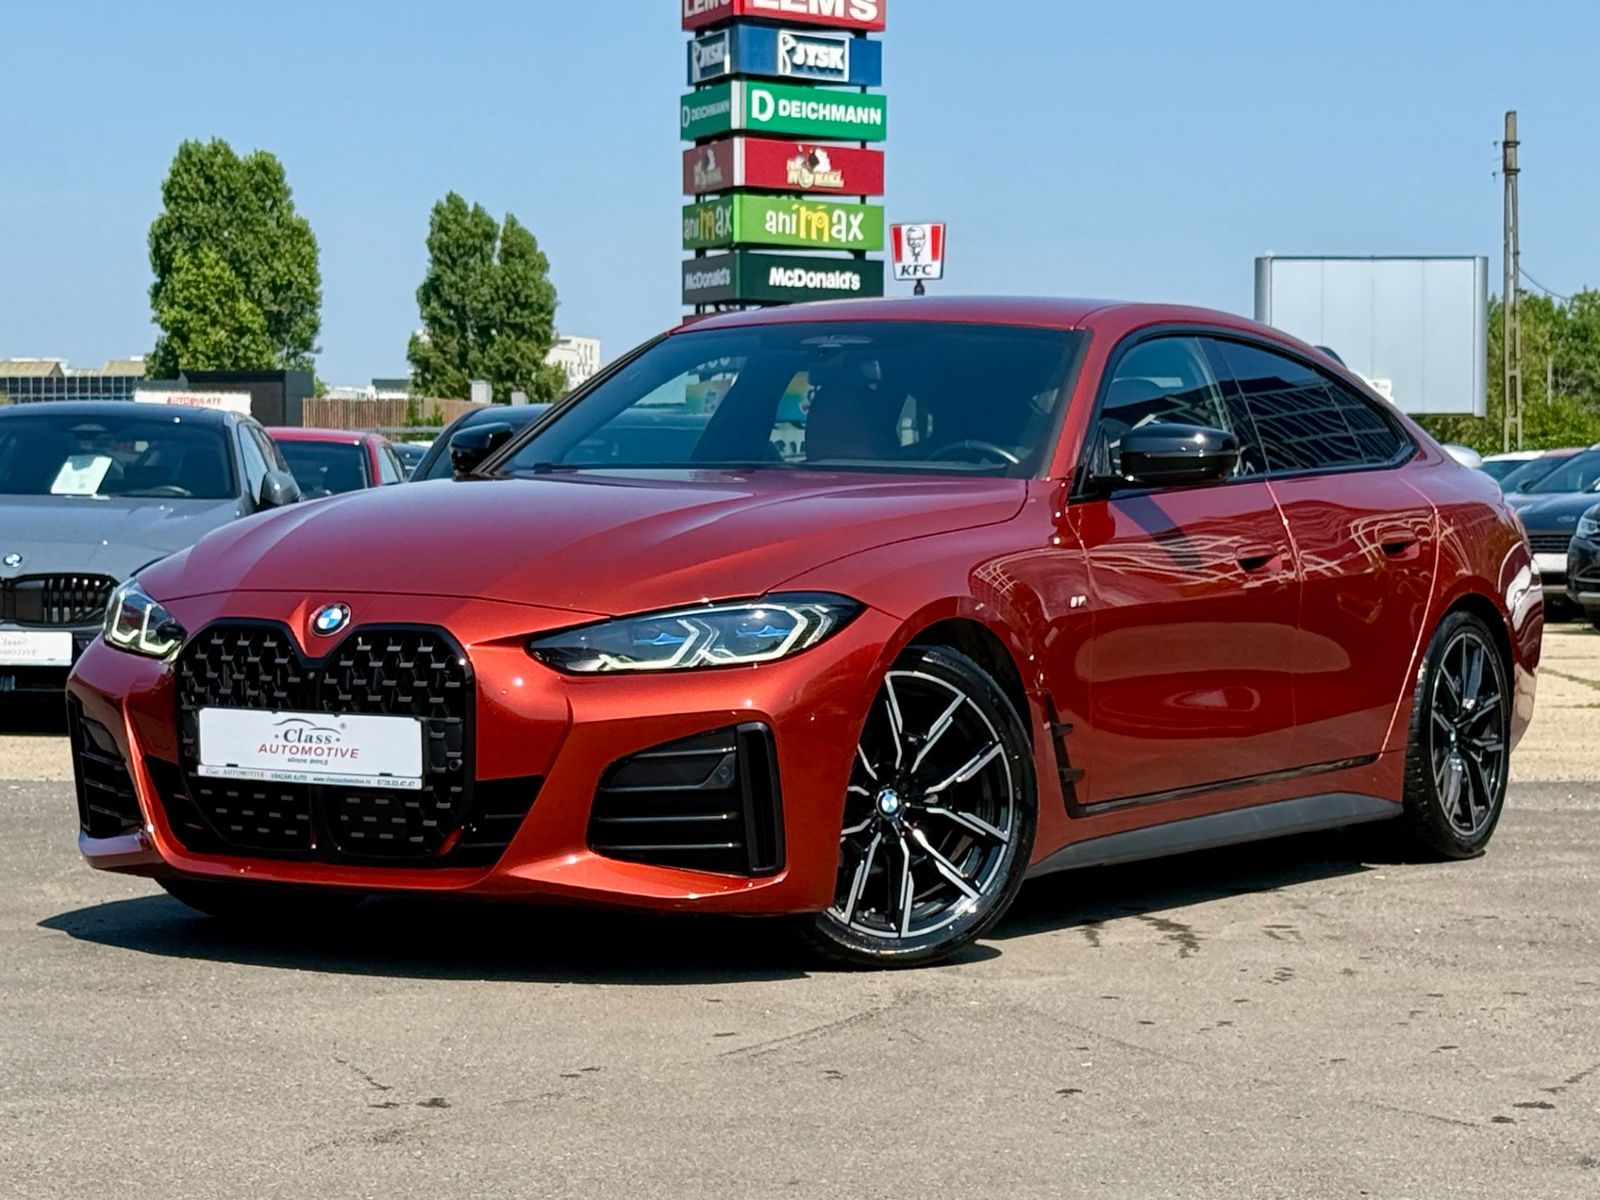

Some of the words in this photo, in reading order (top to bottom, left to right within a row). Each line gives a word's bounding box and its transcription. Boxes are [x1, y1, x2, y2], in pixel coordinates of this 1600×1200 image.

[792, 43, 845, 69] JYSK
[778, 99, 882, 125] DEICHMANN
[765, 203, 864, 242] animax
[769, 267, 860, 290] McDonald's
[901, 264, 933, 277] KFC
[283, 728, 332, 744] Class
[258, 743, 360, 759] AUTOMOTIVE
